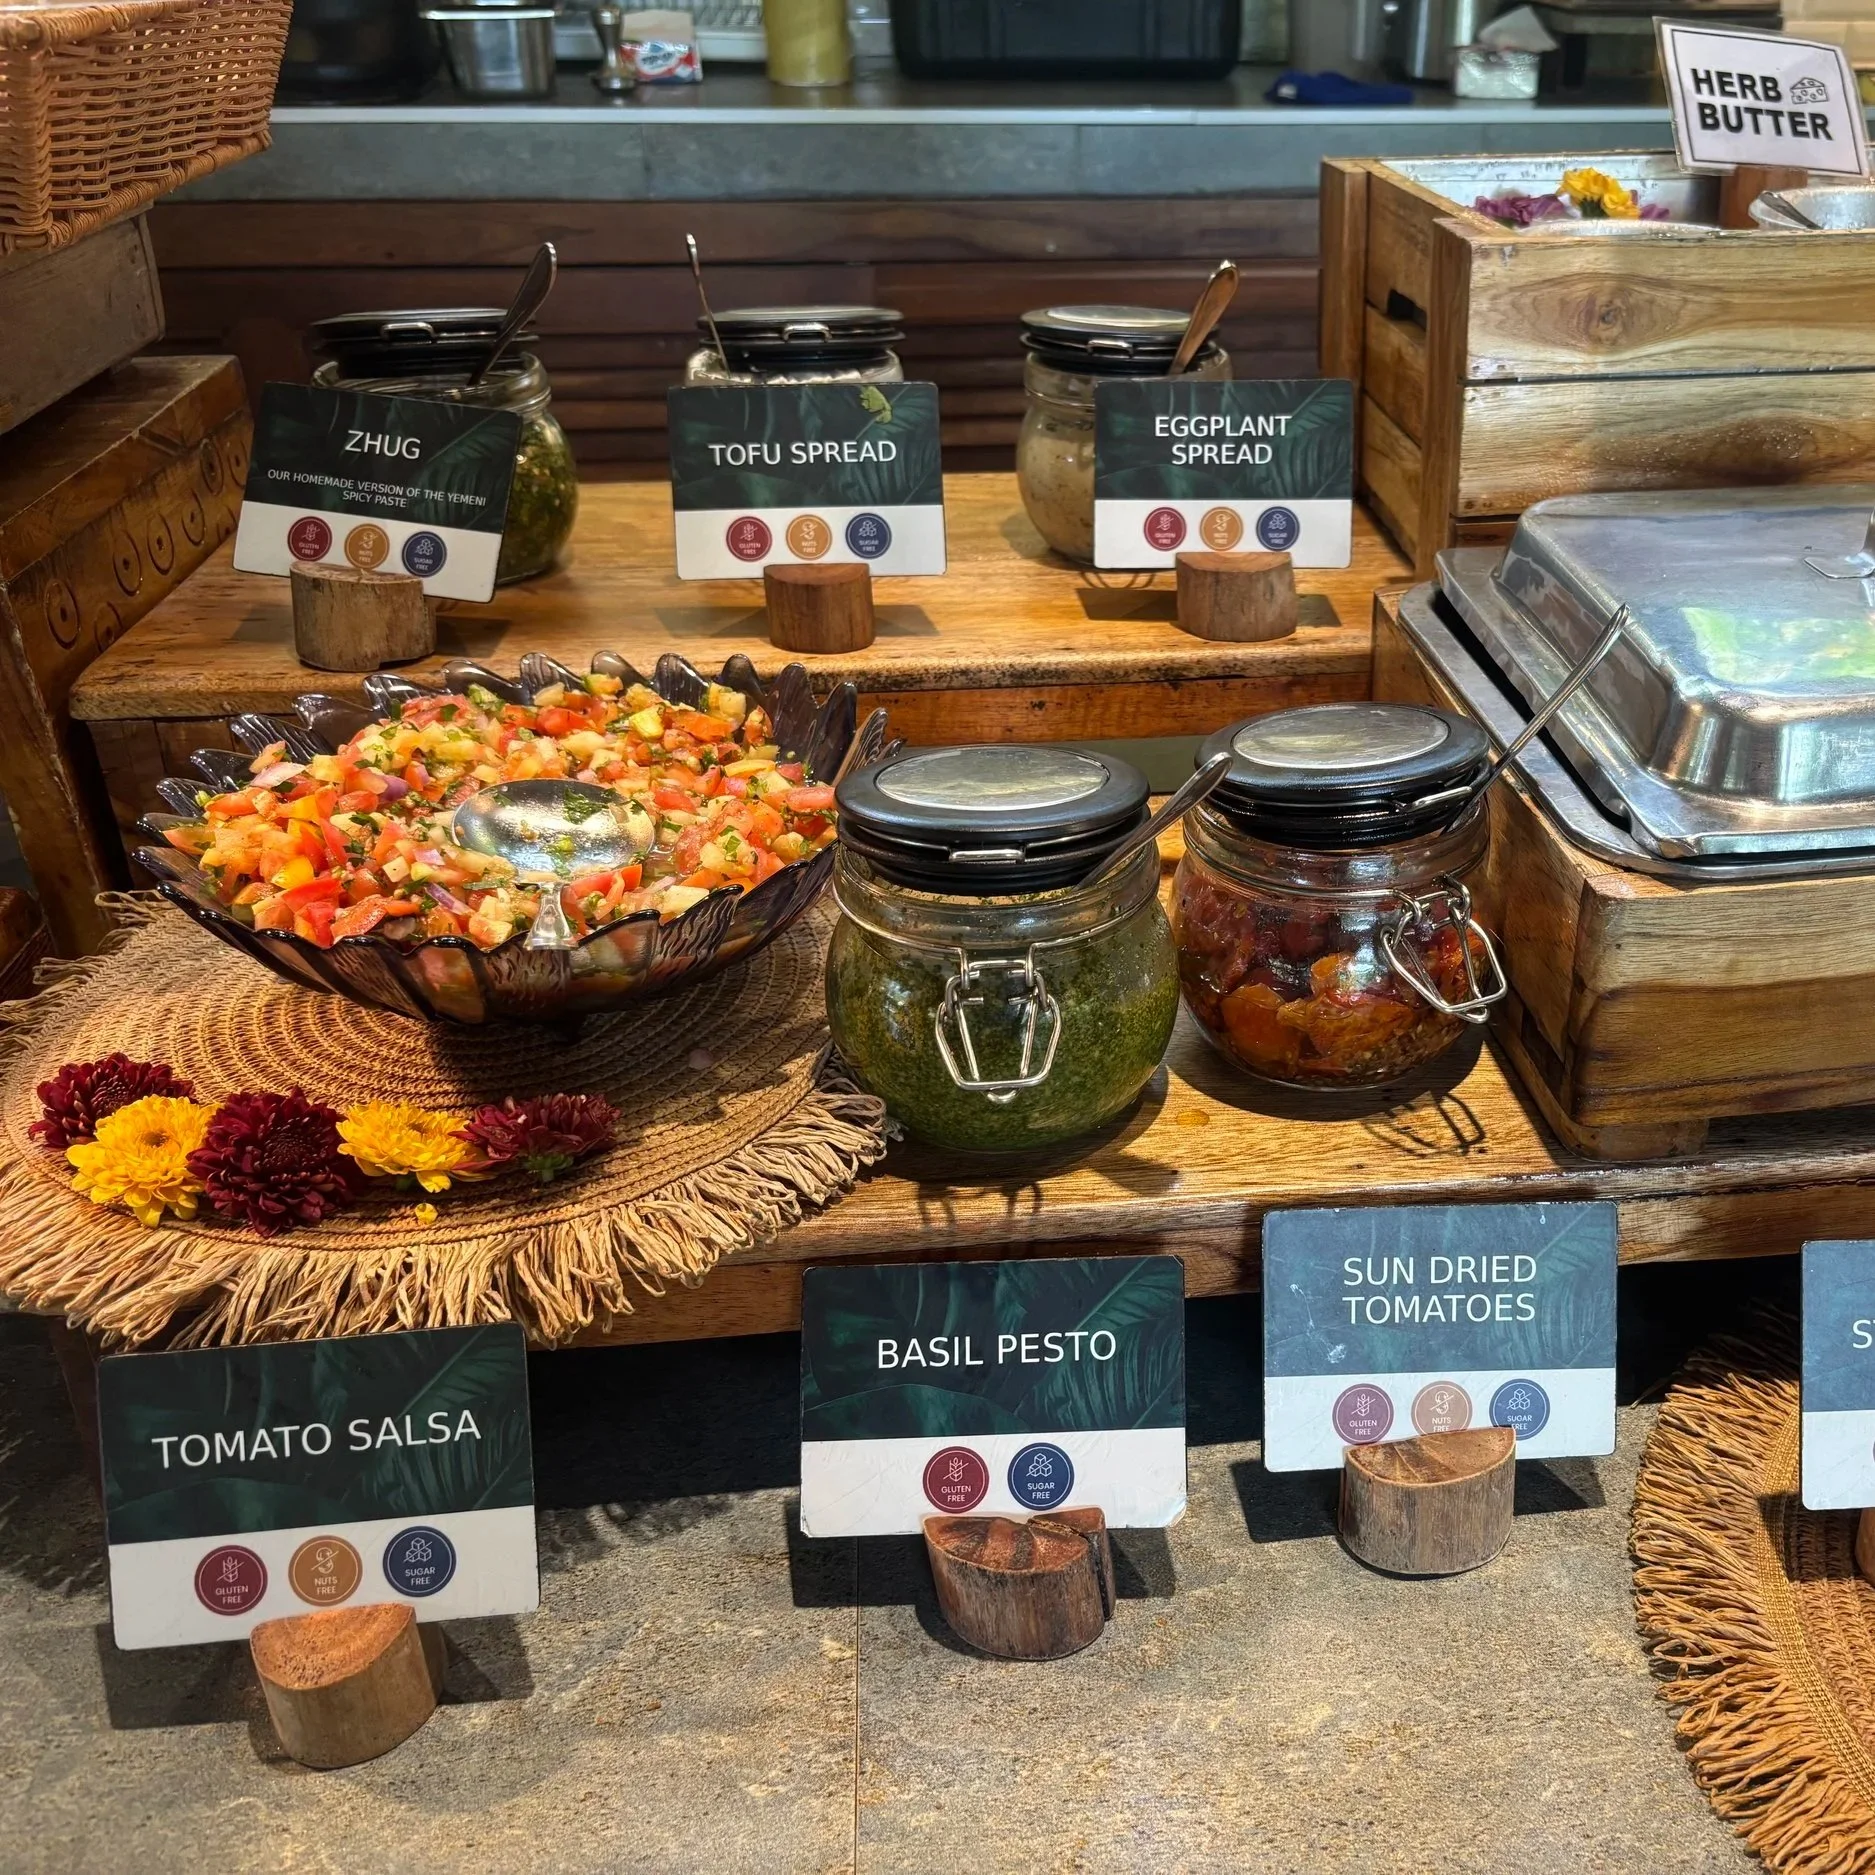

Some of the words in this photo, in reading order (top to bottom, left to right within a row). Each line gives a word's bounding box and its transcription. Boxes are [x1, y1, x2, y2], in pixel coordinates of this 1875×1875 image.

[1691, 68, 1782, 103] HERB
[1697, 102, 1833, 141] BUTTER
[1154, 415, 1292, 437] EGGPLANT
[345, 430, 421, 459] ZHUG
[709, 443, 781, 466] TOFU
[790, 440, 897, 465] SPREAD
[1171, 444, 1273, 465] SPREAD
[267, 469, 291, 481] OUR
[293, 473, 354, 489] HOMEMADE
[357, 481, 404, 496] VERSION
[406, 487, 421, 498] OF
[423, 489, 444, 501] THE
[446, 492, 486, 506] YEMENI
[342, 490, 373, 503] SPICY
[374, 494, 407, 508] PASTE
[1342, 1257, 1415, 1286] SUN
[1430, 1255, 1538, 1284] DRIED
[1342, 1293, 1537, 1325] TOMATOES
[1853, 1319, 1875, 1349] S
[877, 1334, 984, 1370] BASIL
[997, 1330, 1117, 1365] PESTO
[1349, 1419, 1378, 1428] GLUTEN
[1432, 1417, 1452, 1426] NUTS
[1507, 1415, 1533, 1424] SUGAR
[1355, 1428, 1372, 1436] FREE
[1434, 1425, 1450, 1433] FREE
[151, 1422, 332, 1469] TOMATO
[348, 1408, 482, 1451] SALSA
[941, 1485, 972, 1495] GLUTEN
[1027, 1482, 1056, 1491] SUGAR
[947, 1494, 966, 1503] FREE
[1032, 1491, 1051, 1500] FREE
[405, 1567, 436, 1577] SUGAR
[314, 1577, 338, 1587] NUTS
[410, 1576, 431, 1586] FREE
[215, 1585, 249, 1596] GLUTEN
[316, 1585, 337, 1595] FREE
[222, 1594, 242, 1604] FREE
